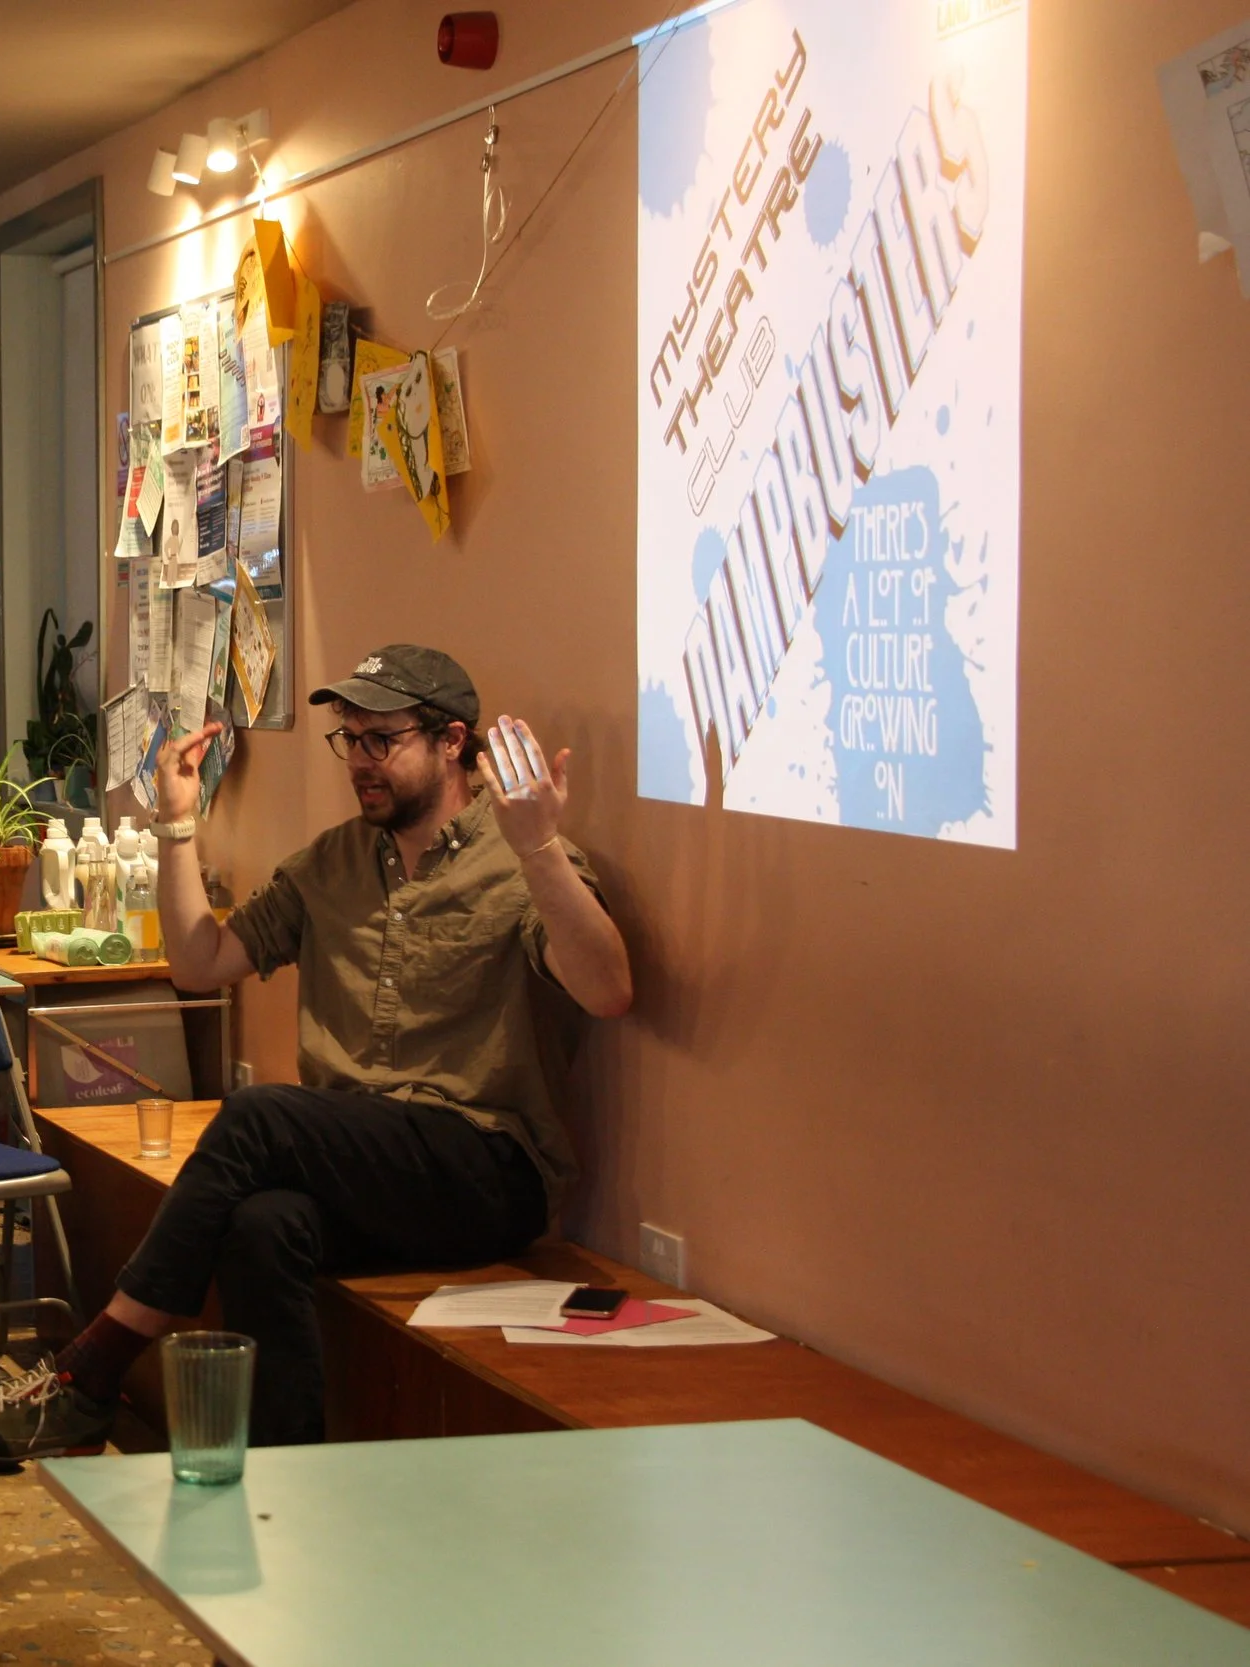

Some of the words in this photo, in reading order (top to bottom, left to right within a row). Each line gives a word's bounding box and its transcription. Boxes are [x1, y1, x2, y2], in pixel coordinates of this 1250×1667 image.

[650, 27, 807, 409] MYSTERY
[663, 106, 823, 455] THEATRE
[682, 62, 990, 800] DAMPBUSTERS
[686, 314, 777, 518] CLUB
[850, 501, 929, 562] THERE'S
[842, 571, 860, 627] A
[868, 568, 904, 627] LOT
[911, 566, 937, 626] OF
[846, 632, 934, 693] CULTURE
[839, 693, 938, 757] GROWING
[874, 760, 904, 821] ON
